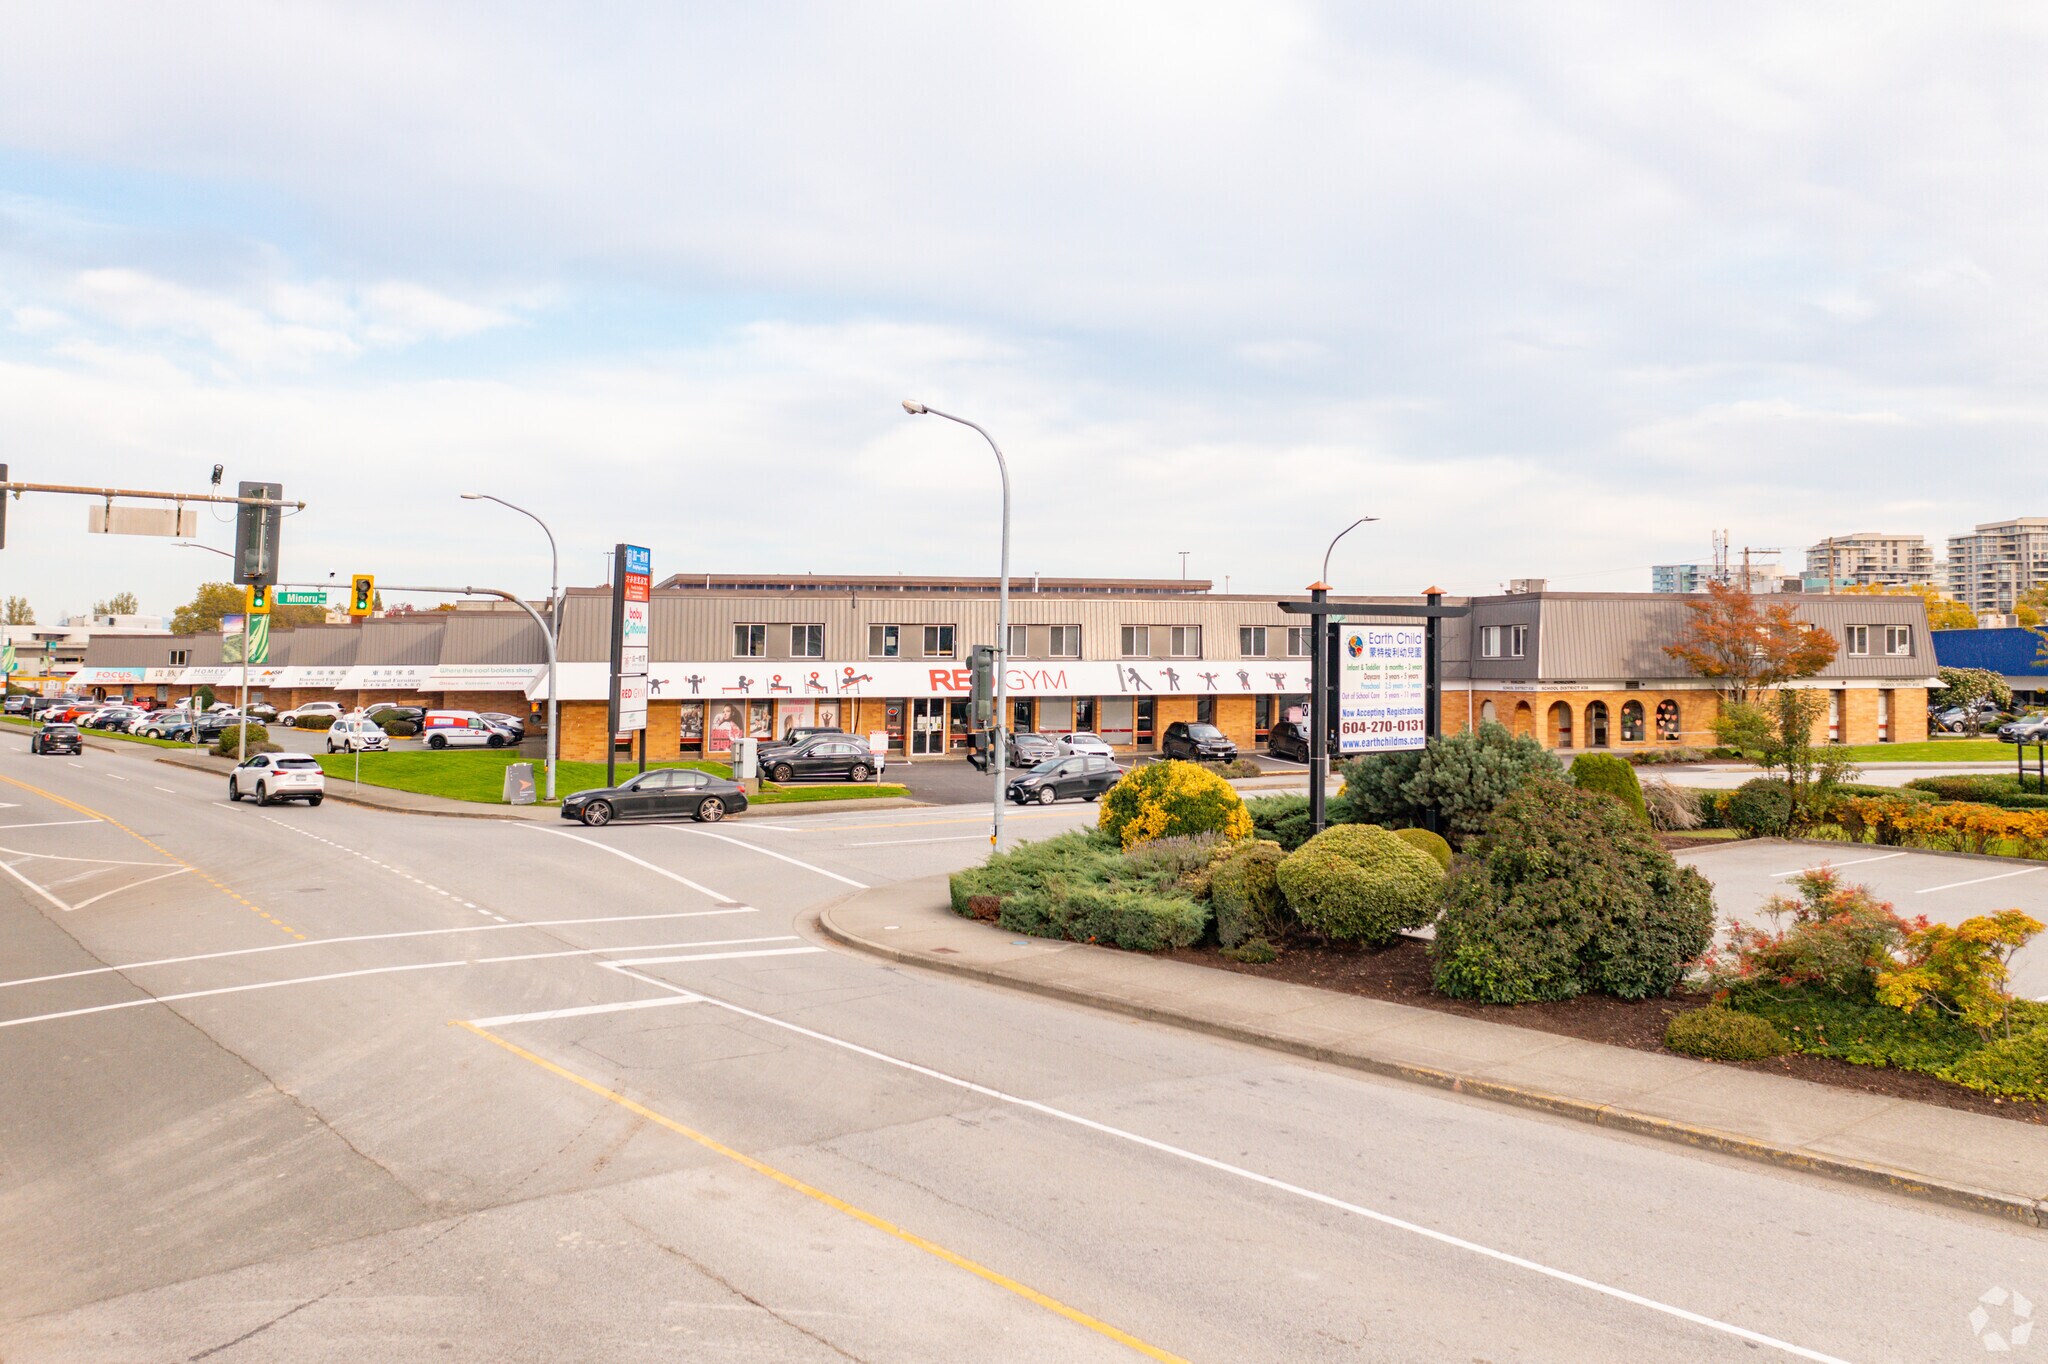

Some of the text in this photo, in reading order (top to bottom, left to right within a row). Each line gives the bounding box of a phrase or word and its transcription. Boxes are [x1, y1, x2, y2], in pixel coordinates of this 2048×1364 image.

[287, 594, 318, 603] Minoru
[629, 607, 642, 622] baby
[1369, 632, 1394, 645] Earth
[1397, 632, 1422, 645] Child
[1006, 669, 1067, 691] GYM
[622, 688, 646, 698] RED GYM
[1342, 707, 1424, 718] Now Accepting Registrations
[1342, 720, 1424, 734] 604-270-0131
[1342, 737, 1424, 749] www.earthchildms.com
